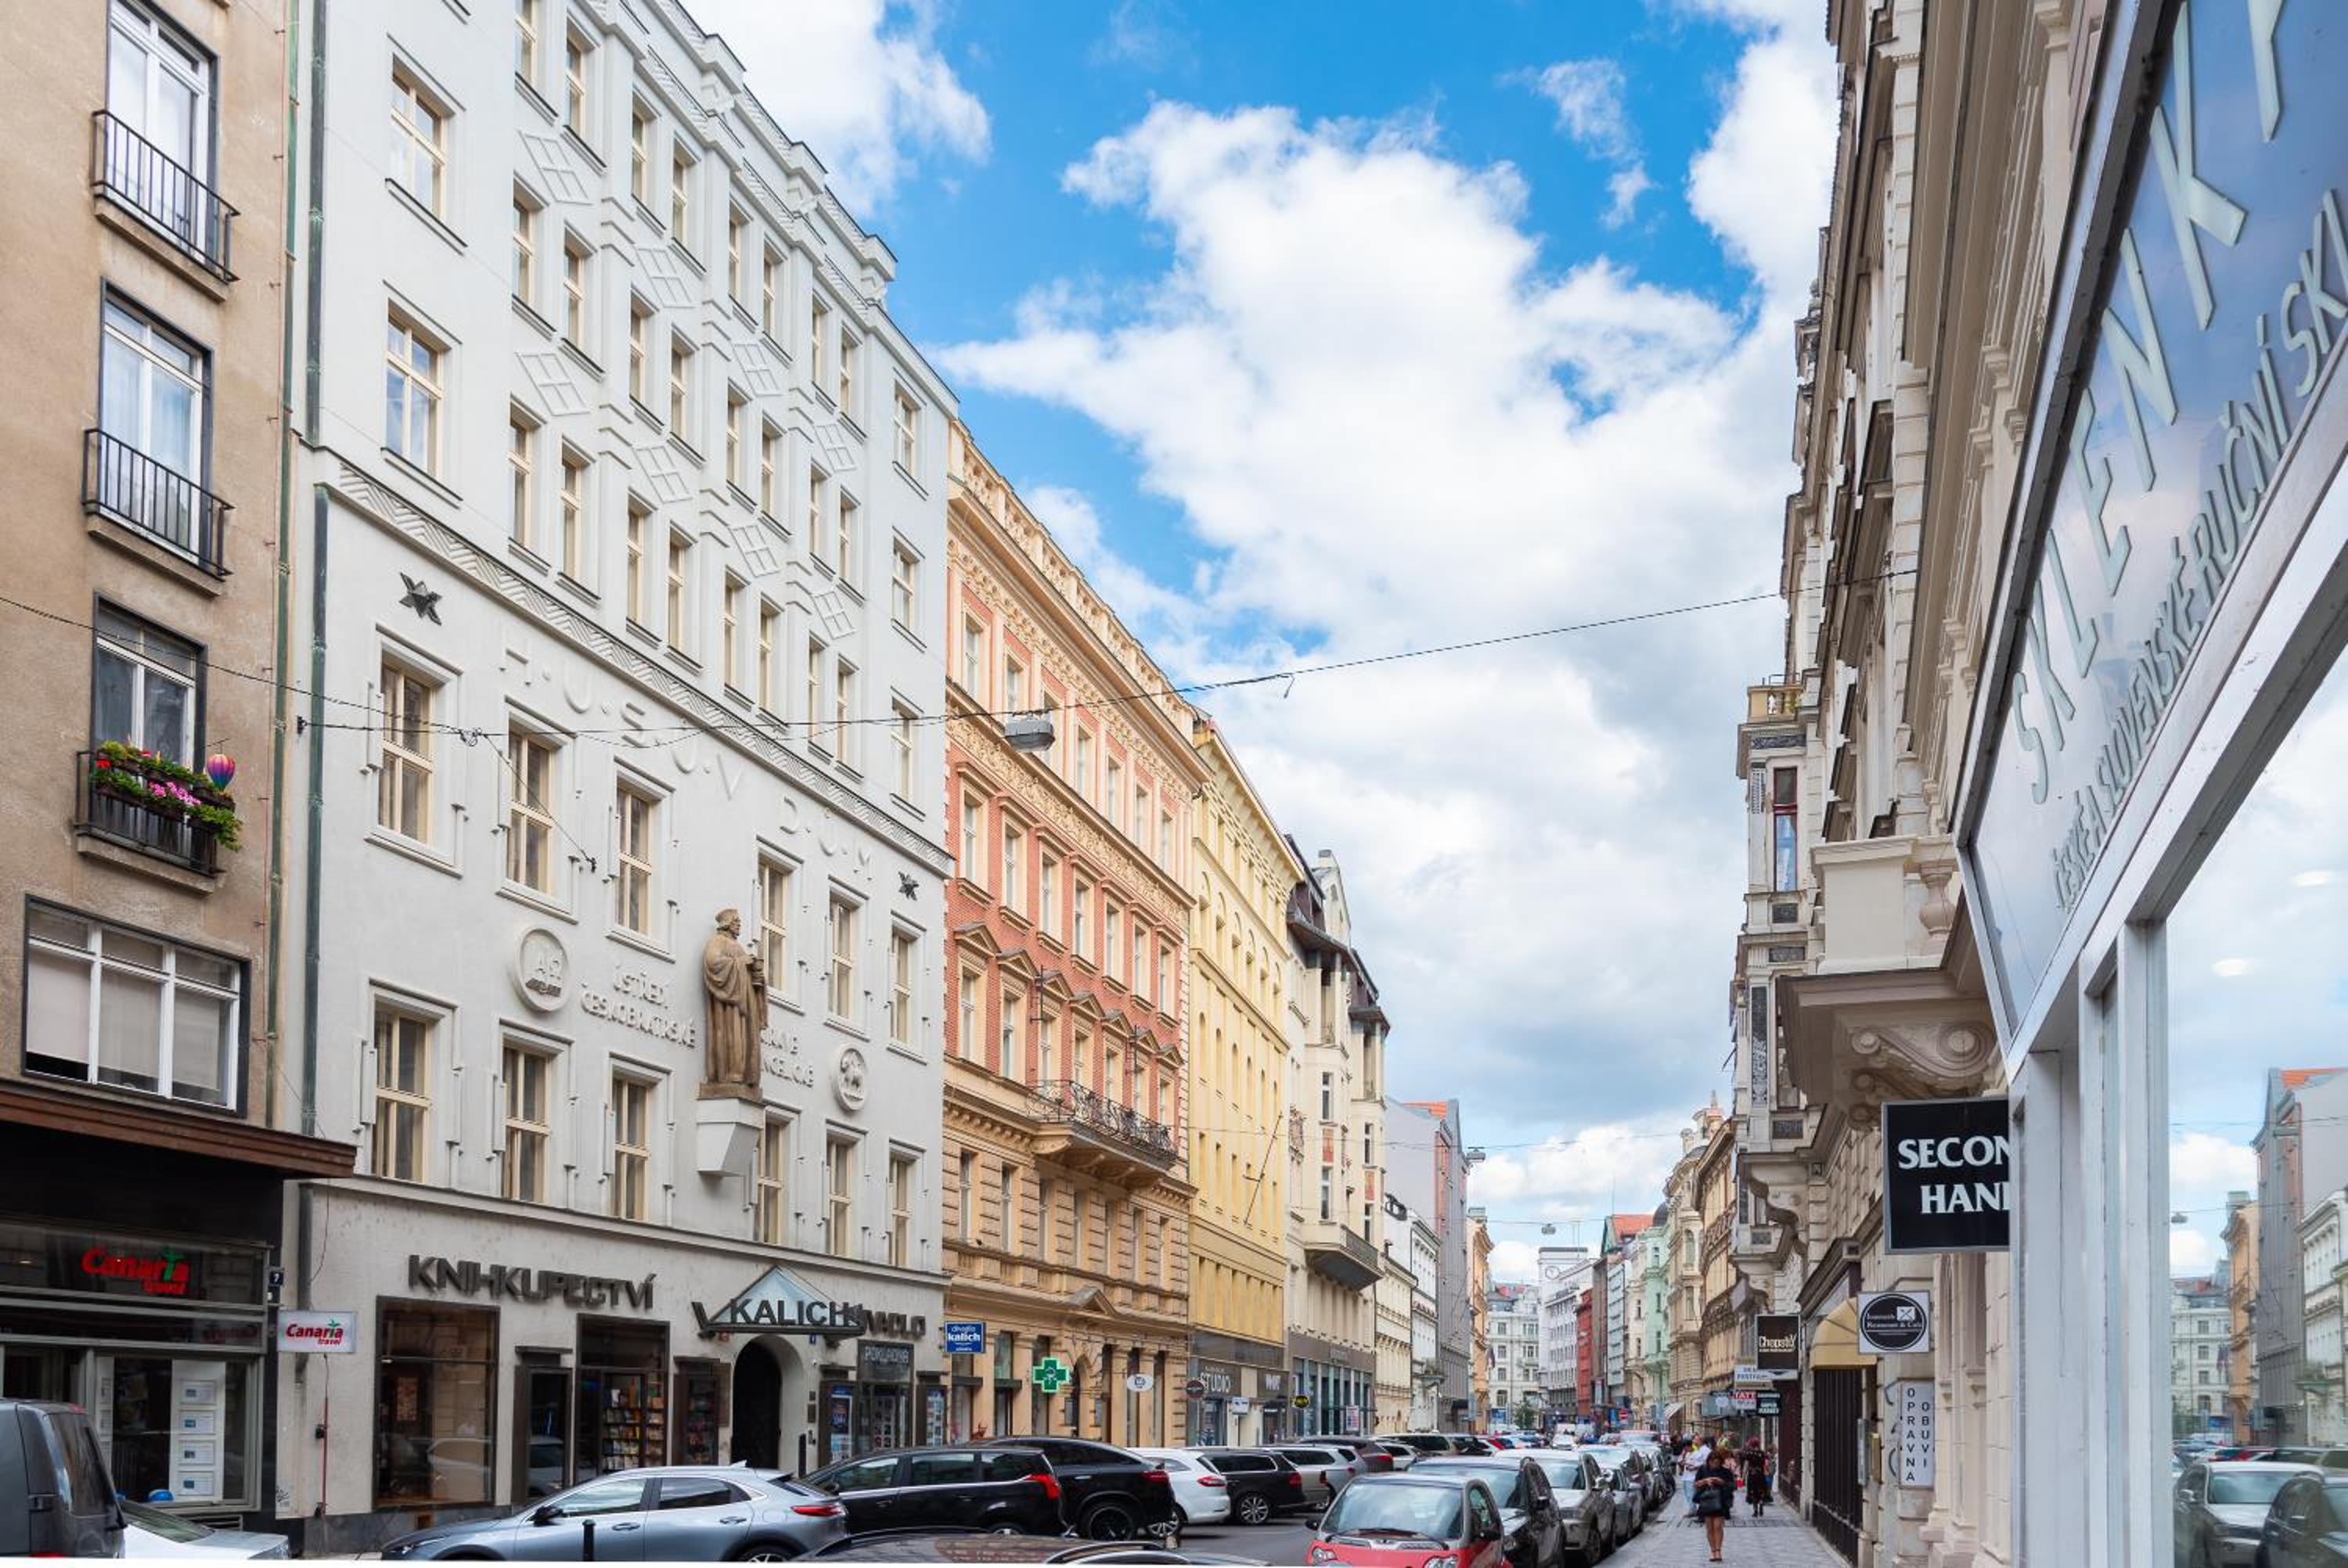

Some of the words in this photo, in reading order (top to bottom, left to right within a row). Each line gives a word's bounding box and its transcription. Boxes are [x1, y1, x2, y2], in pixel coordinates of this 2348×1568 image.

[1898, 1135, 2011, 1169] SECON
[82, 1246, 189, 1281] Canaria
[730, 1299, 848, 1326] KALICH
[286, 1319, 344, 1338] Canaria
[948, 1332, 981, 1342] kalich
[1906, 1387, 1915, 1481] OPRAVNA
